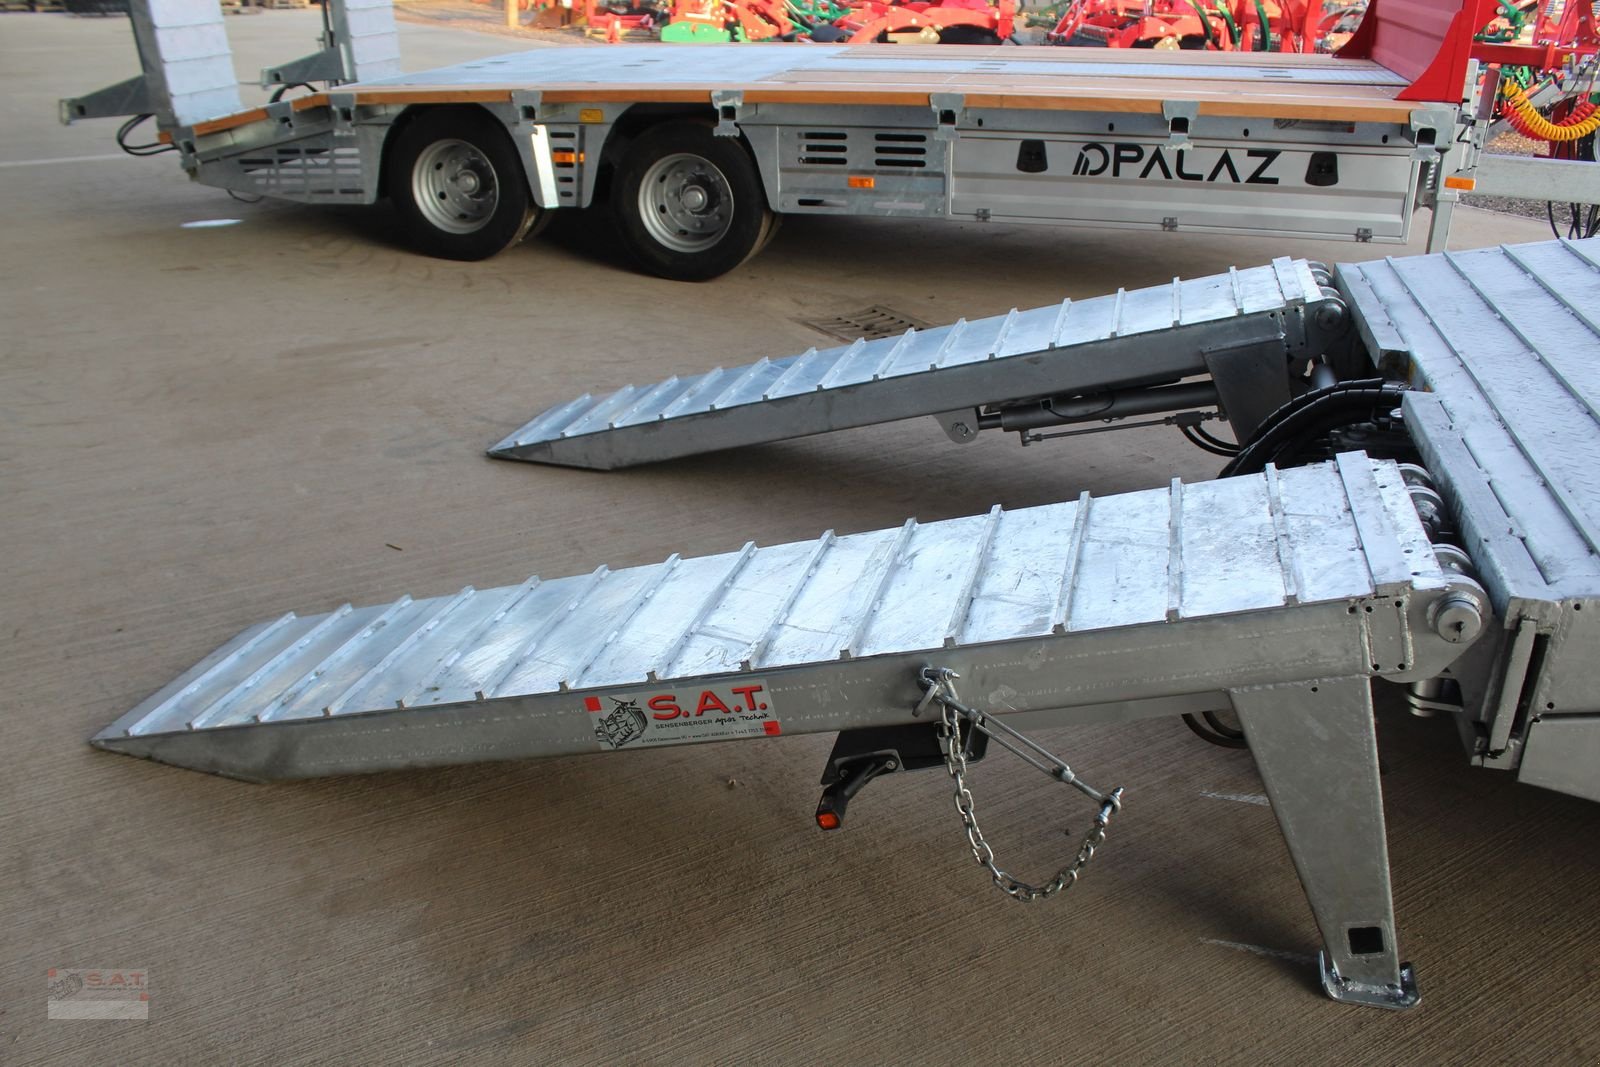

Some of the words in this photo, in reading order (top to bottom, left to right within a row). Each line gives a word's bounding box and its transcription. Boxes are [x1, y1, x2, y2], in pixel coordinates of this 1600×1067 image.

[647, 685, 768, 721] S.A.T.
[655, 719, 713, 729] SENSENBERGER
[739, 713, 769, 721] Technik
